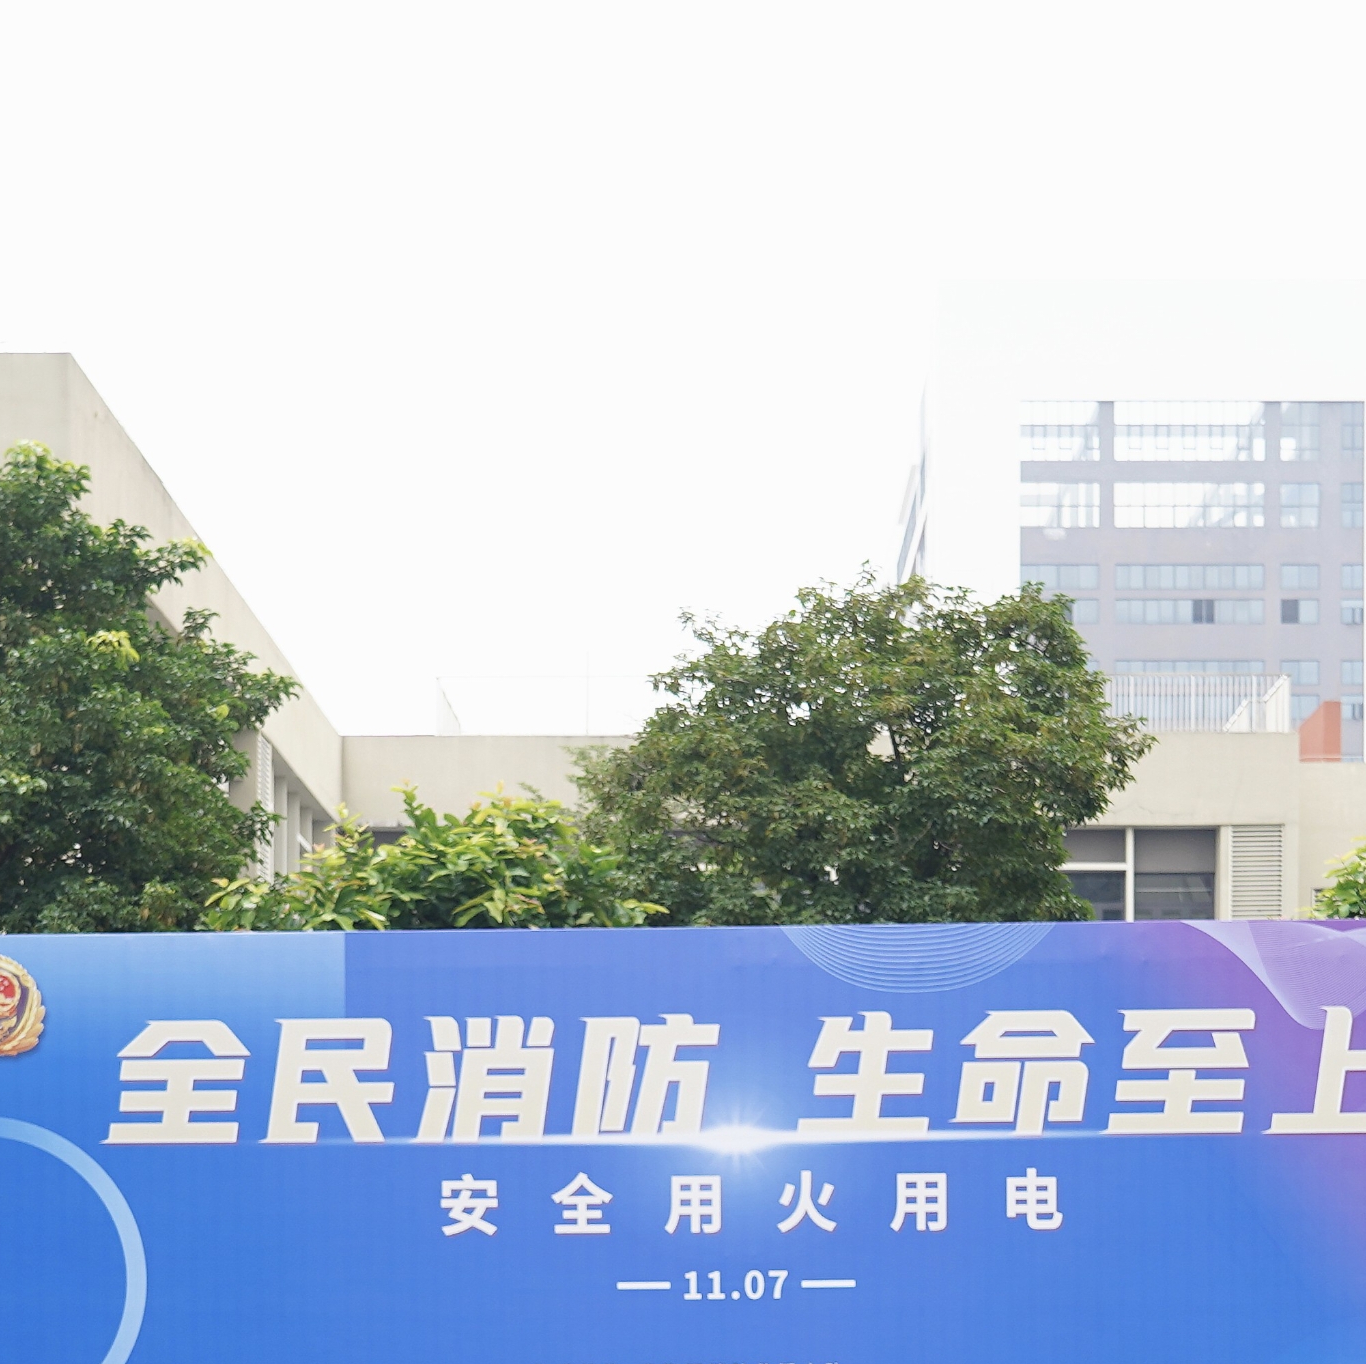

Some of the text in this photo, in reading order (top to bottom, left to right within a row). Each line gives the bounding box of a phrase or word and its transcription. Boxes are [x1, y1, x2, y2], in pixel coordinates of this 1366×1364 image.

[102, 1013, 721, 1145] 全民消防
[440, 1167, 1063, 1236] 安全用火用电
[683, 1269, 789, 1300] 11.07
